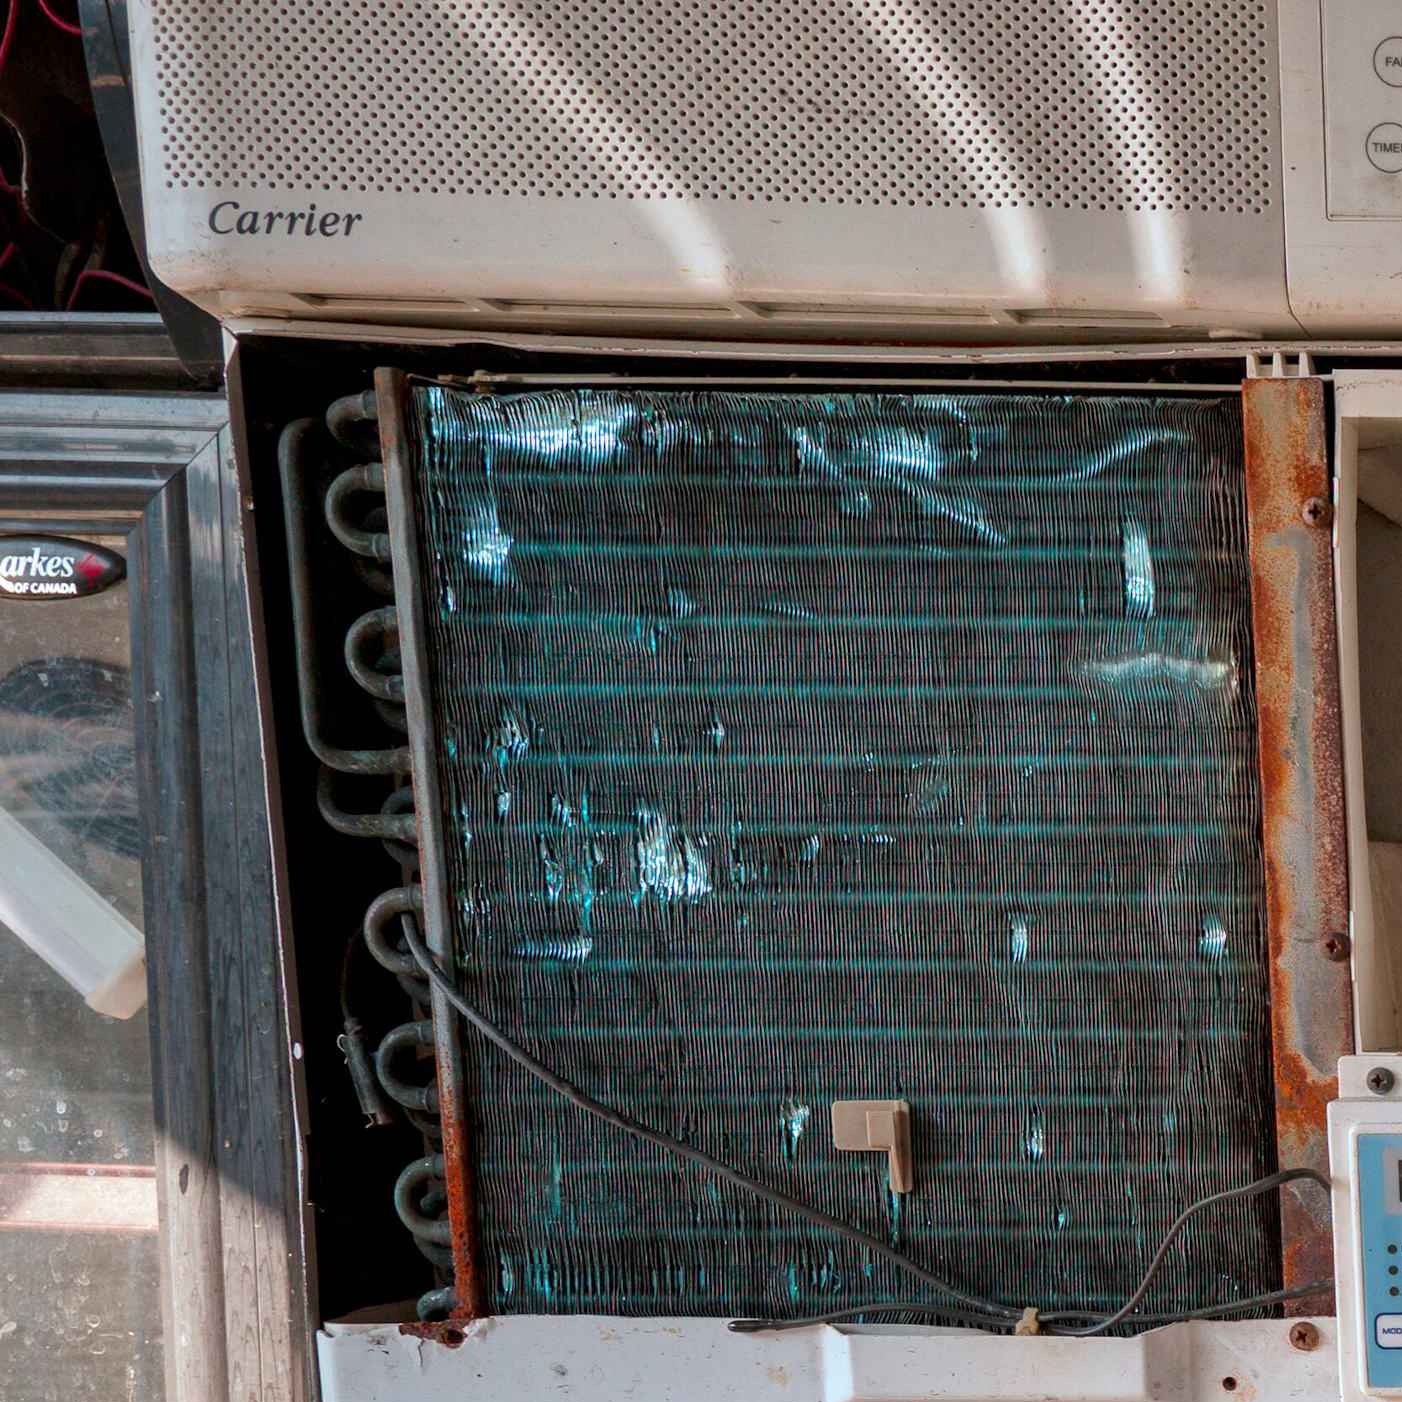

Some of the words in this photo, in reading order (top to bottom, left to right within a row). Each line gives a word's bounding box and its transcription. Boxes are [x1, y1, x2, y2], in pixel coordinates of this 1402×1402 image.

[208, 201, 362, 237] Carrier
[15, 582, 30, 593] OF
[30, 582, 77, 594] CANADA
